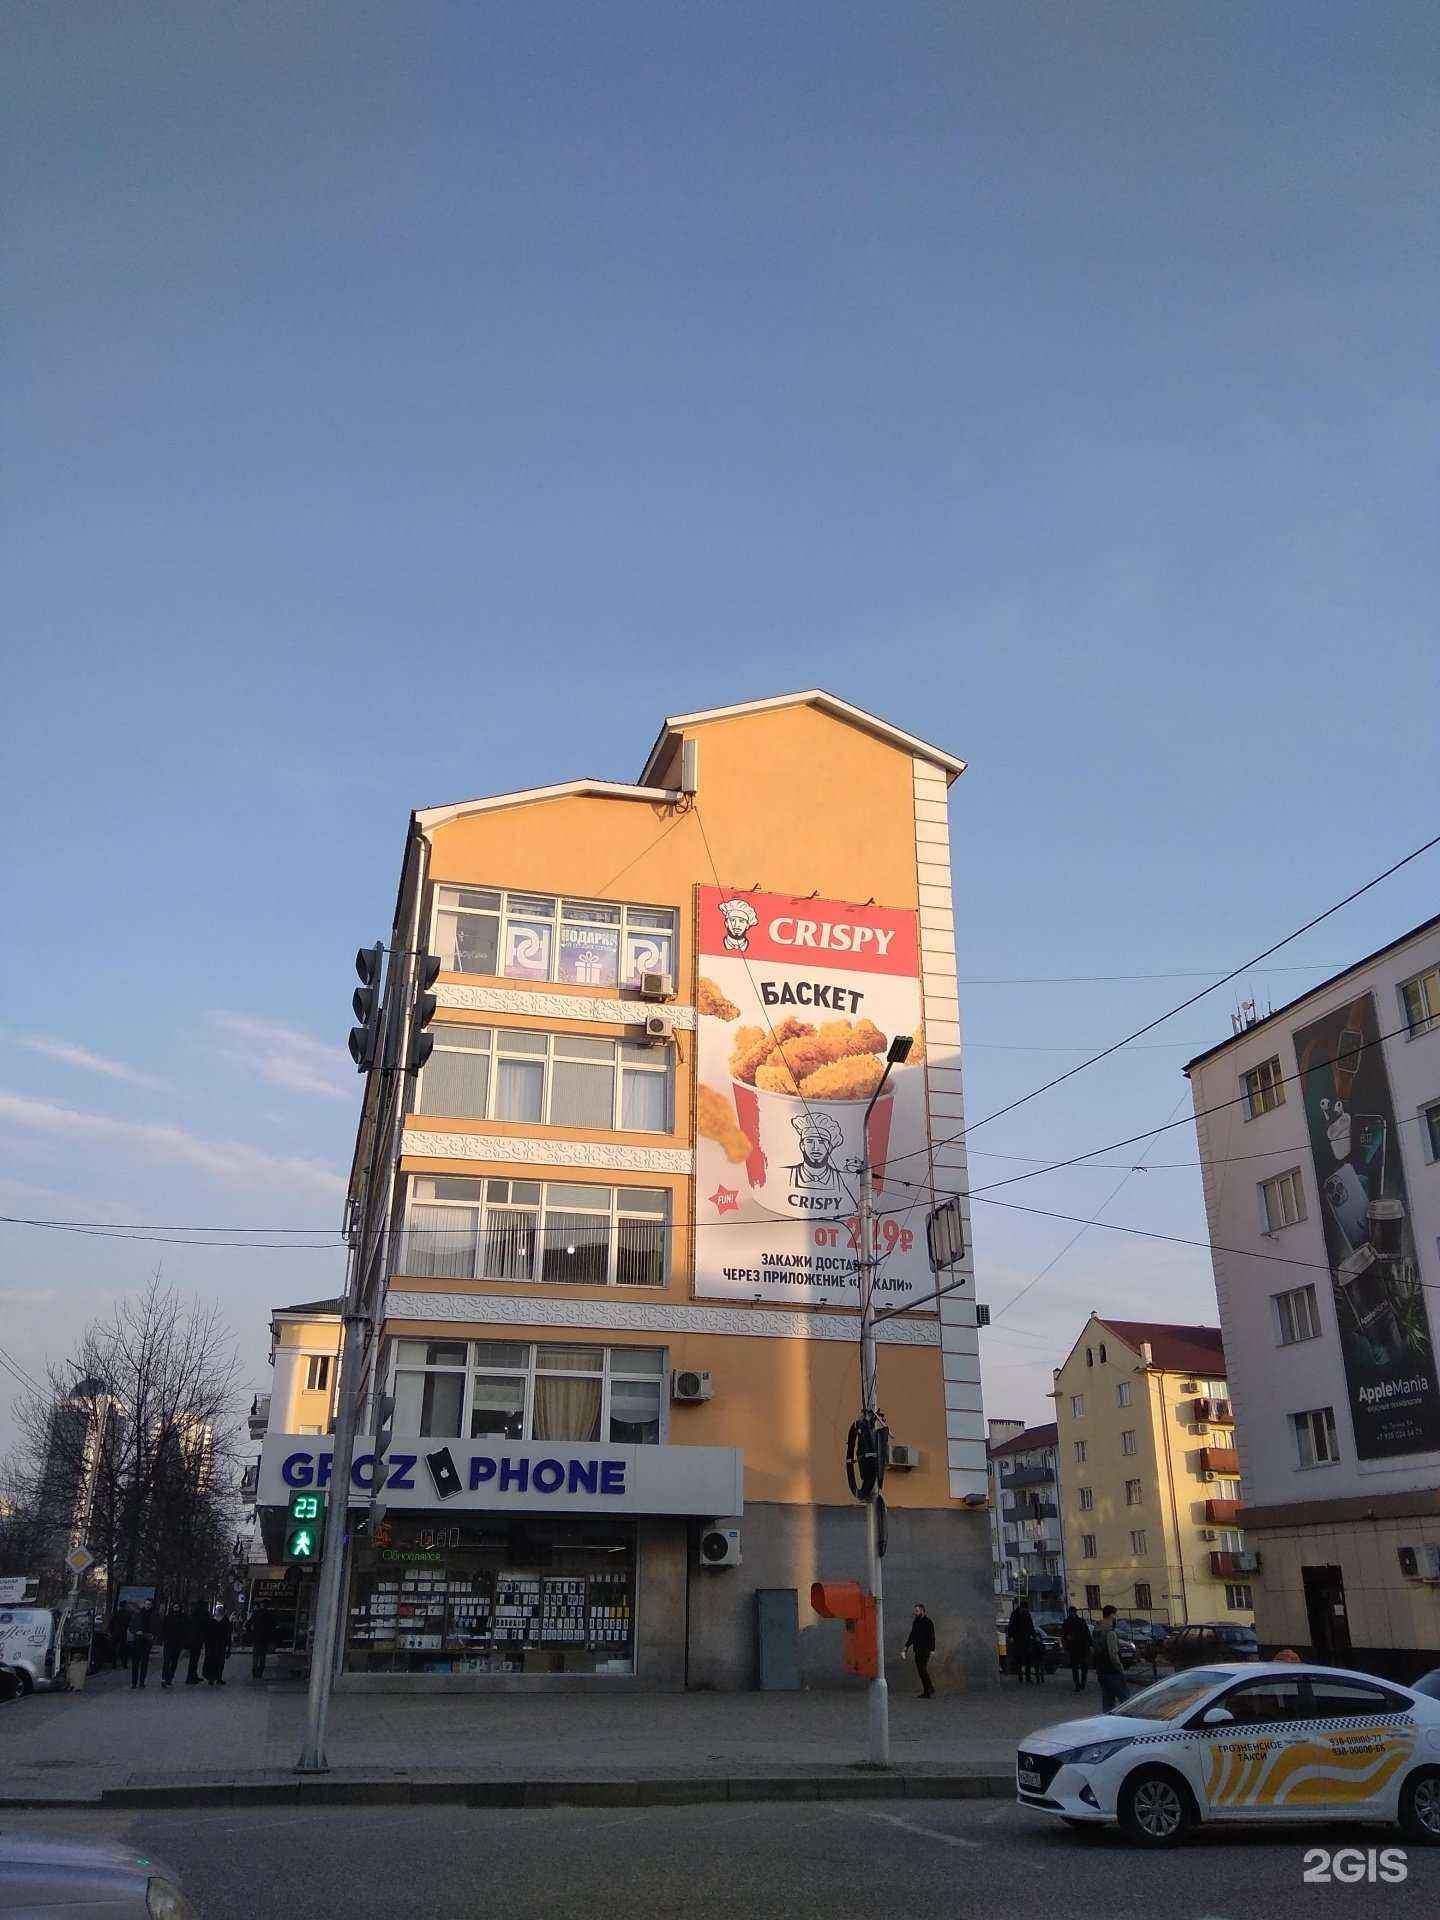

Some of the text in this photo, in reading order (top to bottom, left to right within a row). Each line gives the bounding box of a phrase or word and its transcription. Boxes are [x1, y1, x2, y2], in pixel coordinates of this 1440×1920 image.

[768, 917, 895, 955] CRISPY
[761, 981, 864, 1014] БАСКЕТ
[787, 1194, 844, 1210] CRISPY
[761, 1253, 812, 1268] ЗАКАЖИ
[723, 1268, 760, 1282] ЧЕРЕЗ
[763, 1270, 846, 1288] ПРИЛОЖЕНИЕ
[1359, 1374, 1429, 1405] AppleMania
[469, 1456, 626, 1495] PHONE
[294, 1498, 318, 1518] 23
[1218, 1740, 1283, 1753] ГРОЗНЕНСКОЕ
[1238, 1753, 1268, 1762] ТАКСИ
